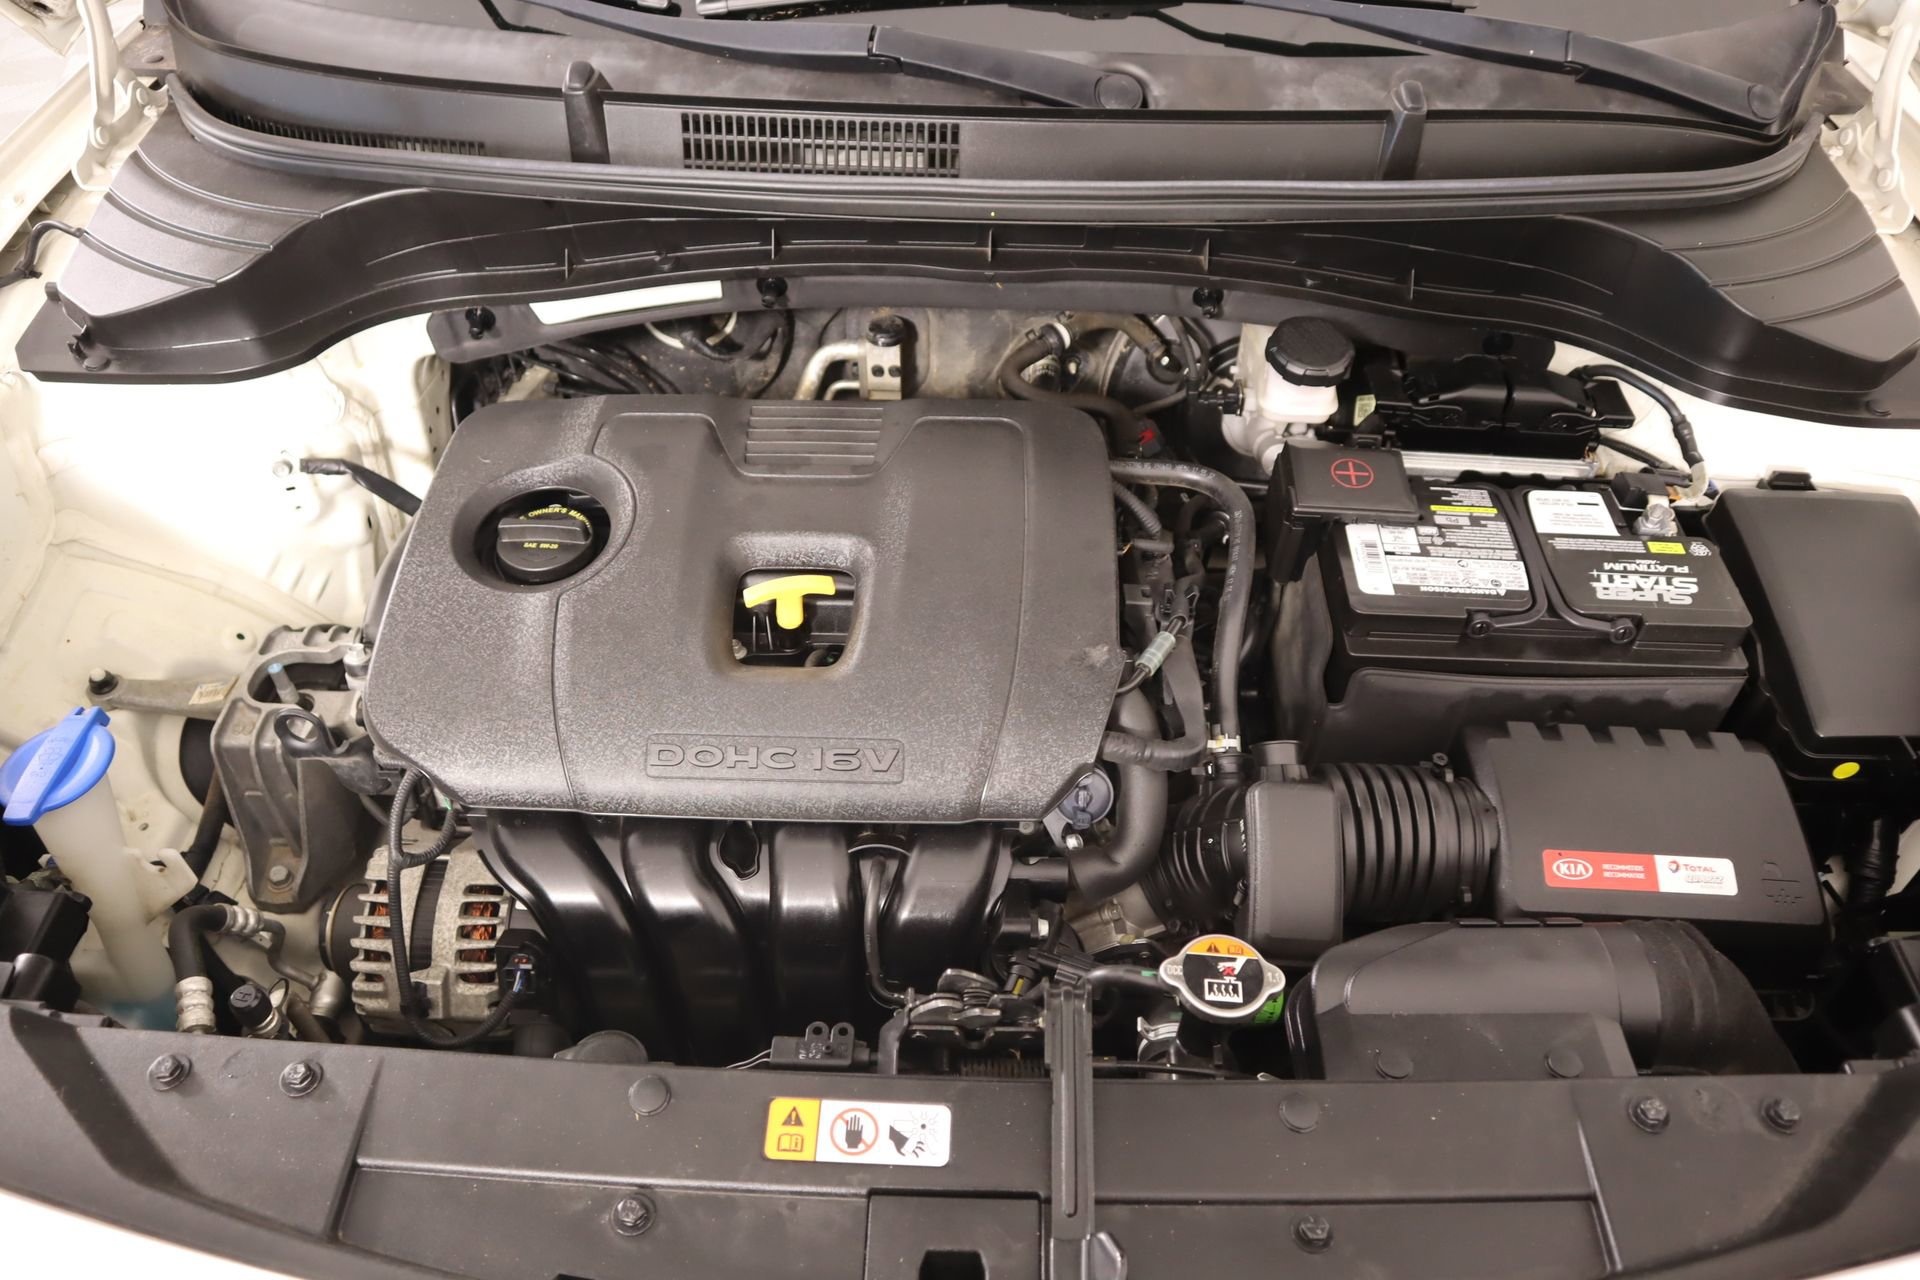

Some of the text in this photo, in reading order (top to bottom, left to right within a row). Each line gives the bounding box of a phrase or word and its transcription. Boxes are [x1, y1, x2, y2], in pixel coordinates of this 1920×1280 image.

[528, 507, 568, 518] OWNER'S
[1603, 562, 1689, 573] PLATINUM
[1590, 573, 1699, 594] START
[1596, 586, 1693, 605] SUPER
[648, 743, 900, 773] DOHC 16V
[1559, 862, 1587, 875] KIA
[1683, 863, 1717, 873] TOTAL
